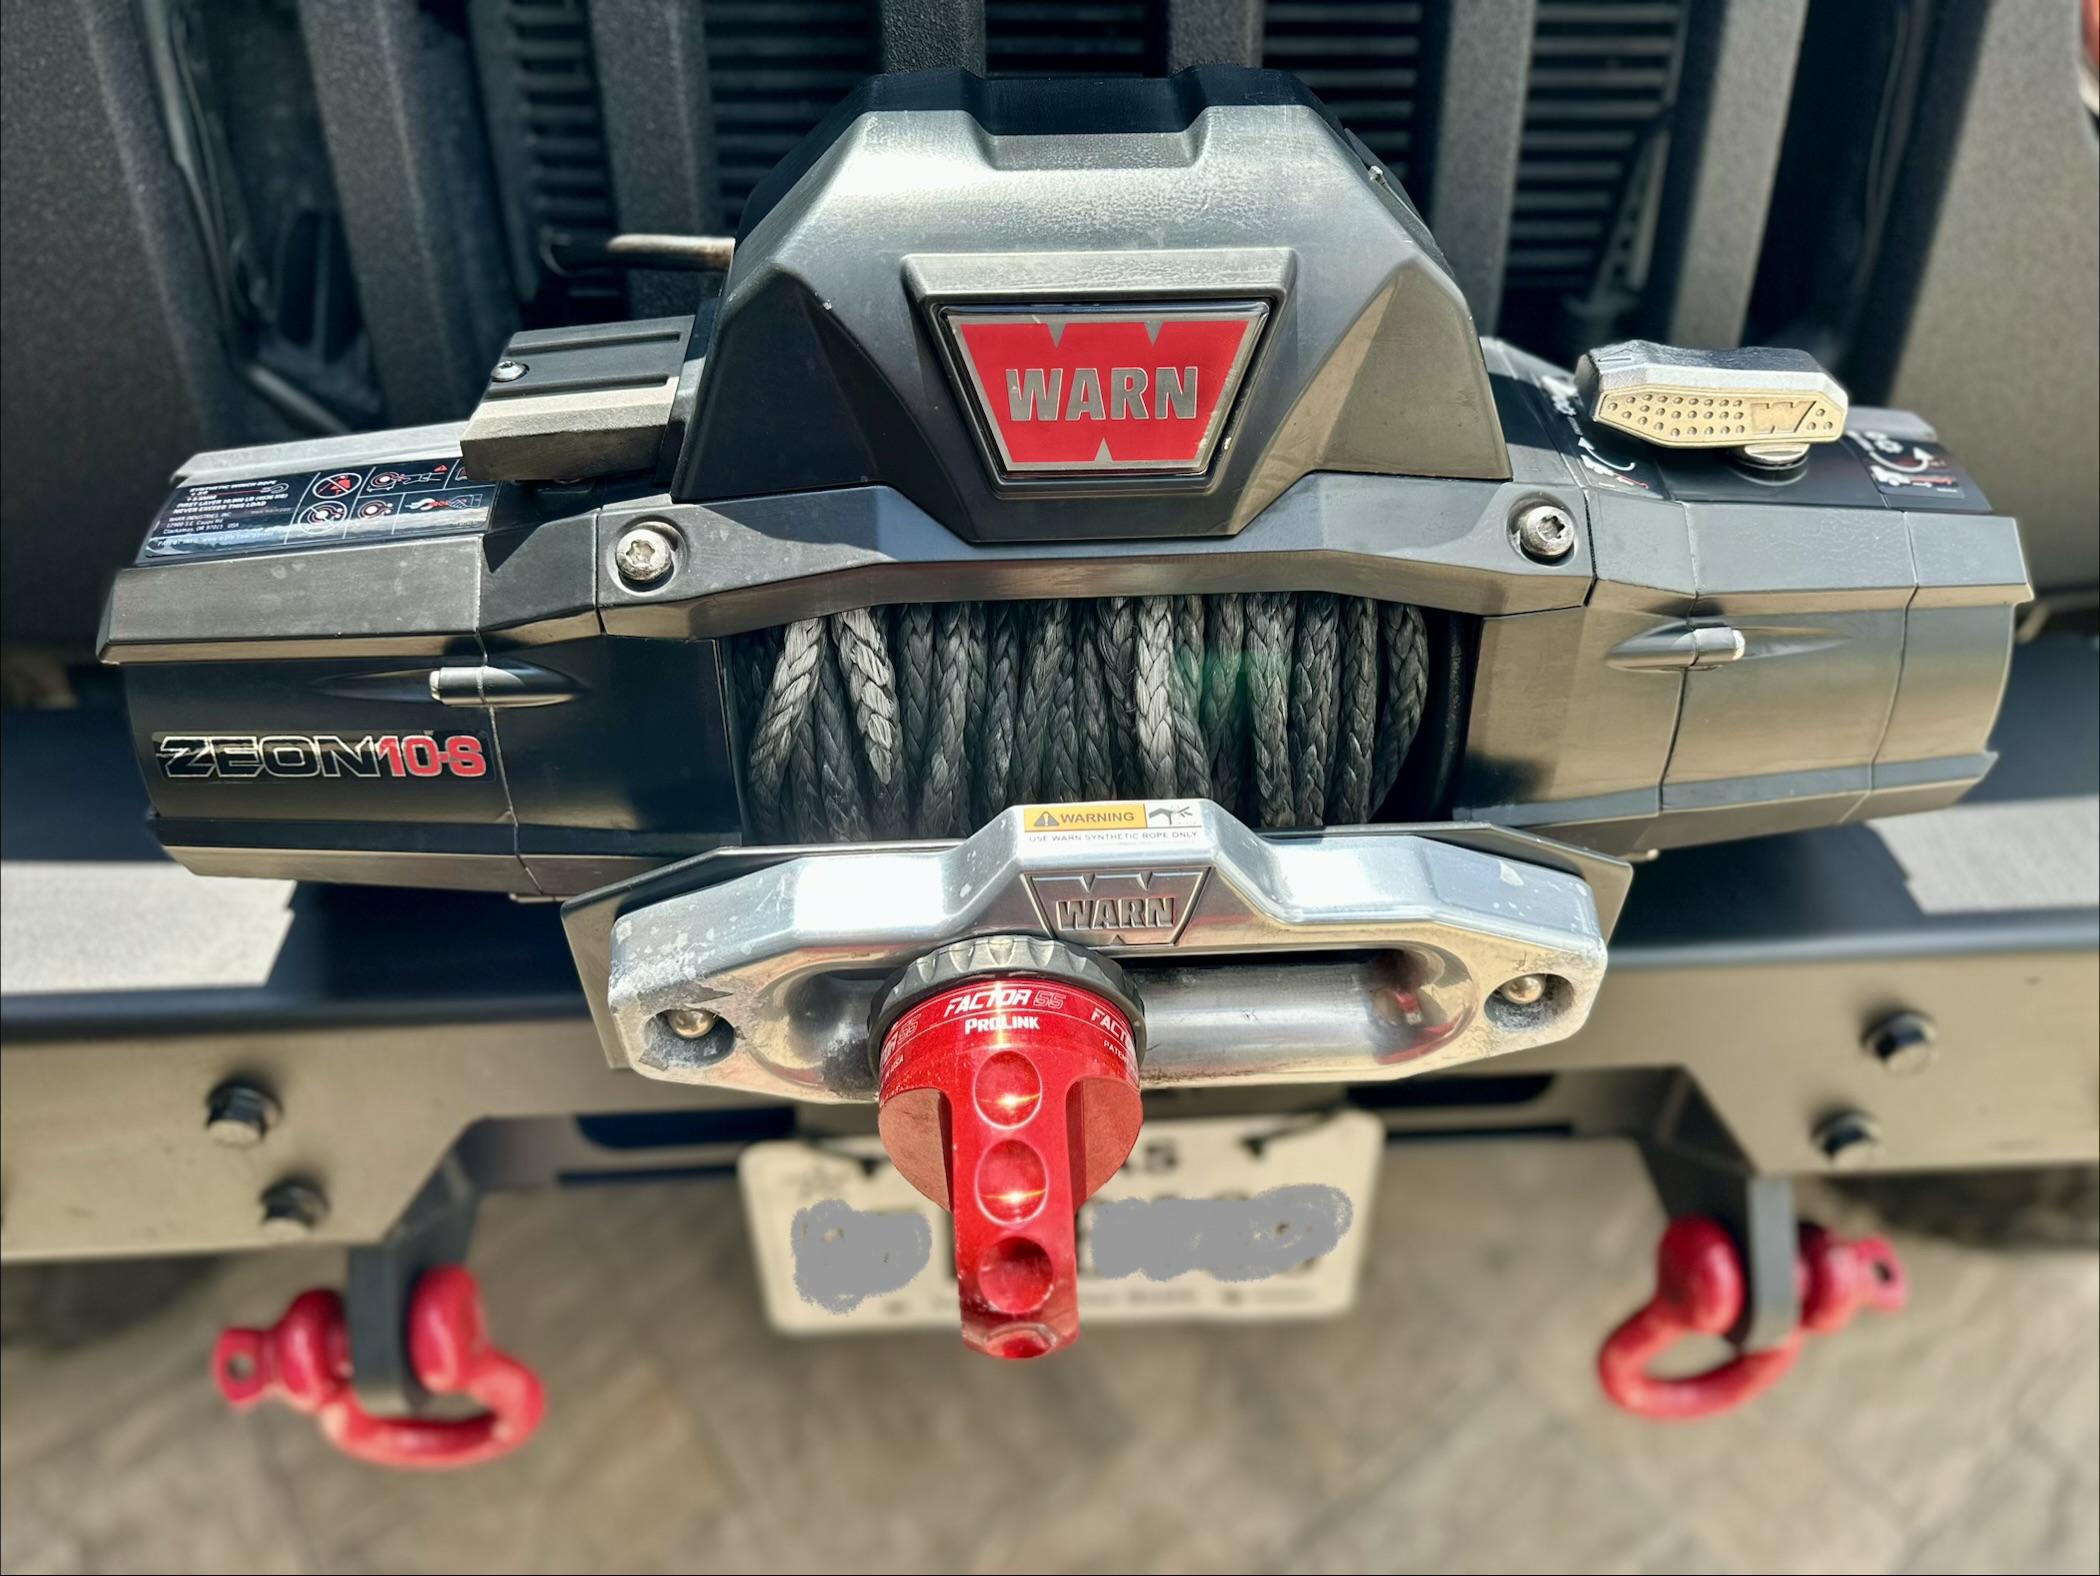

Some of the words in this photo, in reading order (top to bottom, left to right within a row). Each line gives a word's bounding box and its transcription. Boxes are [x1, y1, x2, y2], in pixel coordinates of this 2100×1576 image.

[1005, 366, 1198, 421] WARN
[176, 501, 199, 509] FIRST
[160, 736, 380, 777] ZEON
[378, 735, 487, 777] 10-S
[1060, 811, 1135, 824] WARNING
[1052, 834, 1082, 842] WARN
[1085, 832, 1139, 841] SYNTHETIC
[1142, 831, 1168, 839] ROPE
[1172, 830, 1198, 838] ONLY
[1056, 897, 1175, 931] WARN
[944, 989, 1032, 1018] FACTOR
